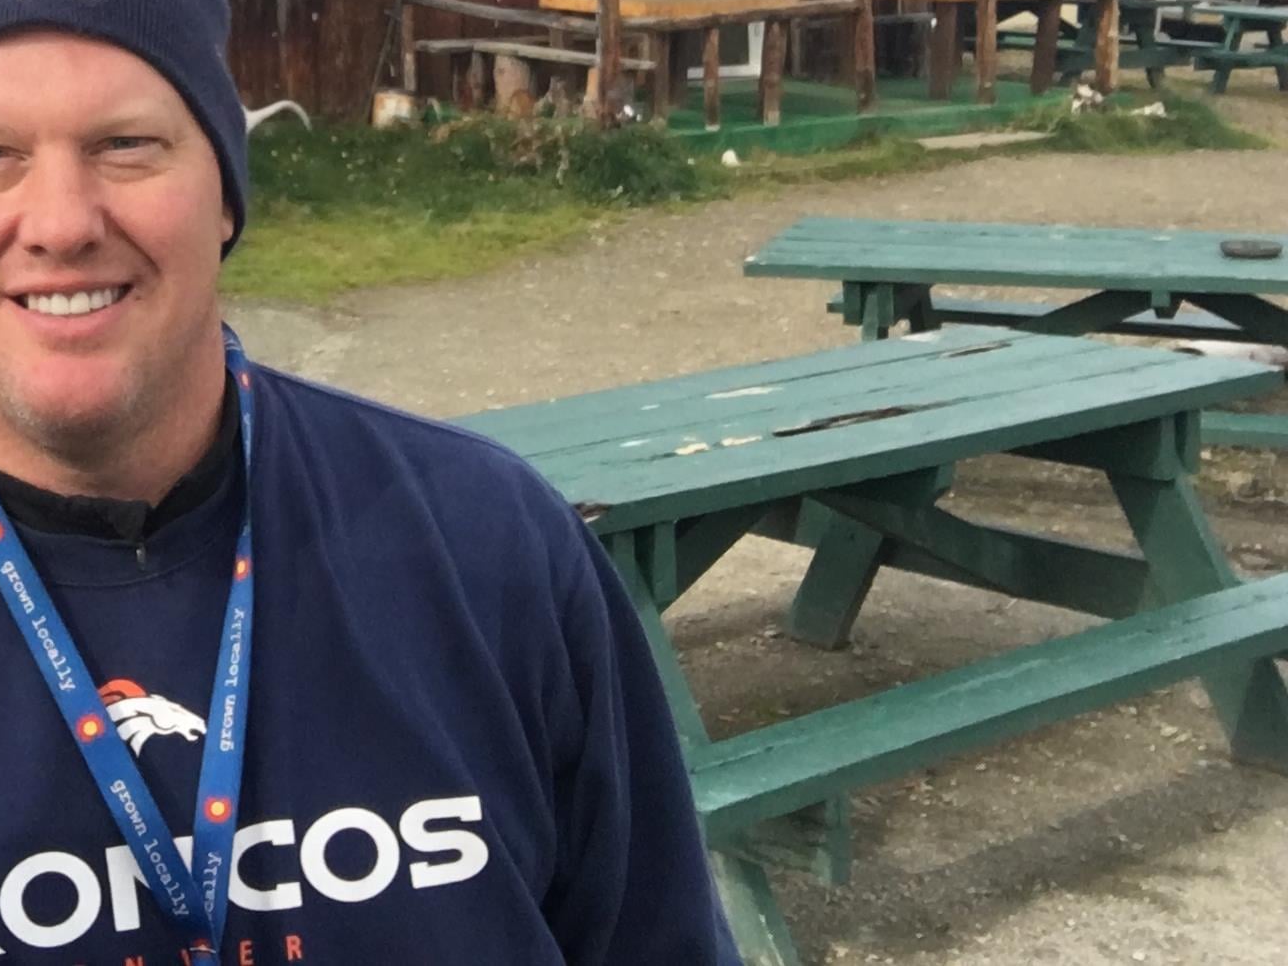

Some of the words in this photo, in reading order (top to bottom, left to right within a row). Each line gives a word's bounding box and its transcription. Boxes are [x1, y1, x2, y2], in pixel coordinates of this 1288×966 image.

[0, 560, 35, 614] grown
[31, 615, 77, 691] locally
[221, 607, 245, 687] locally
[219, 694, 236, 752] grown
[109, 779, 147, 837] grown
[143, 838, 190, 916] locally
[202, 851, 223, 922] cally
